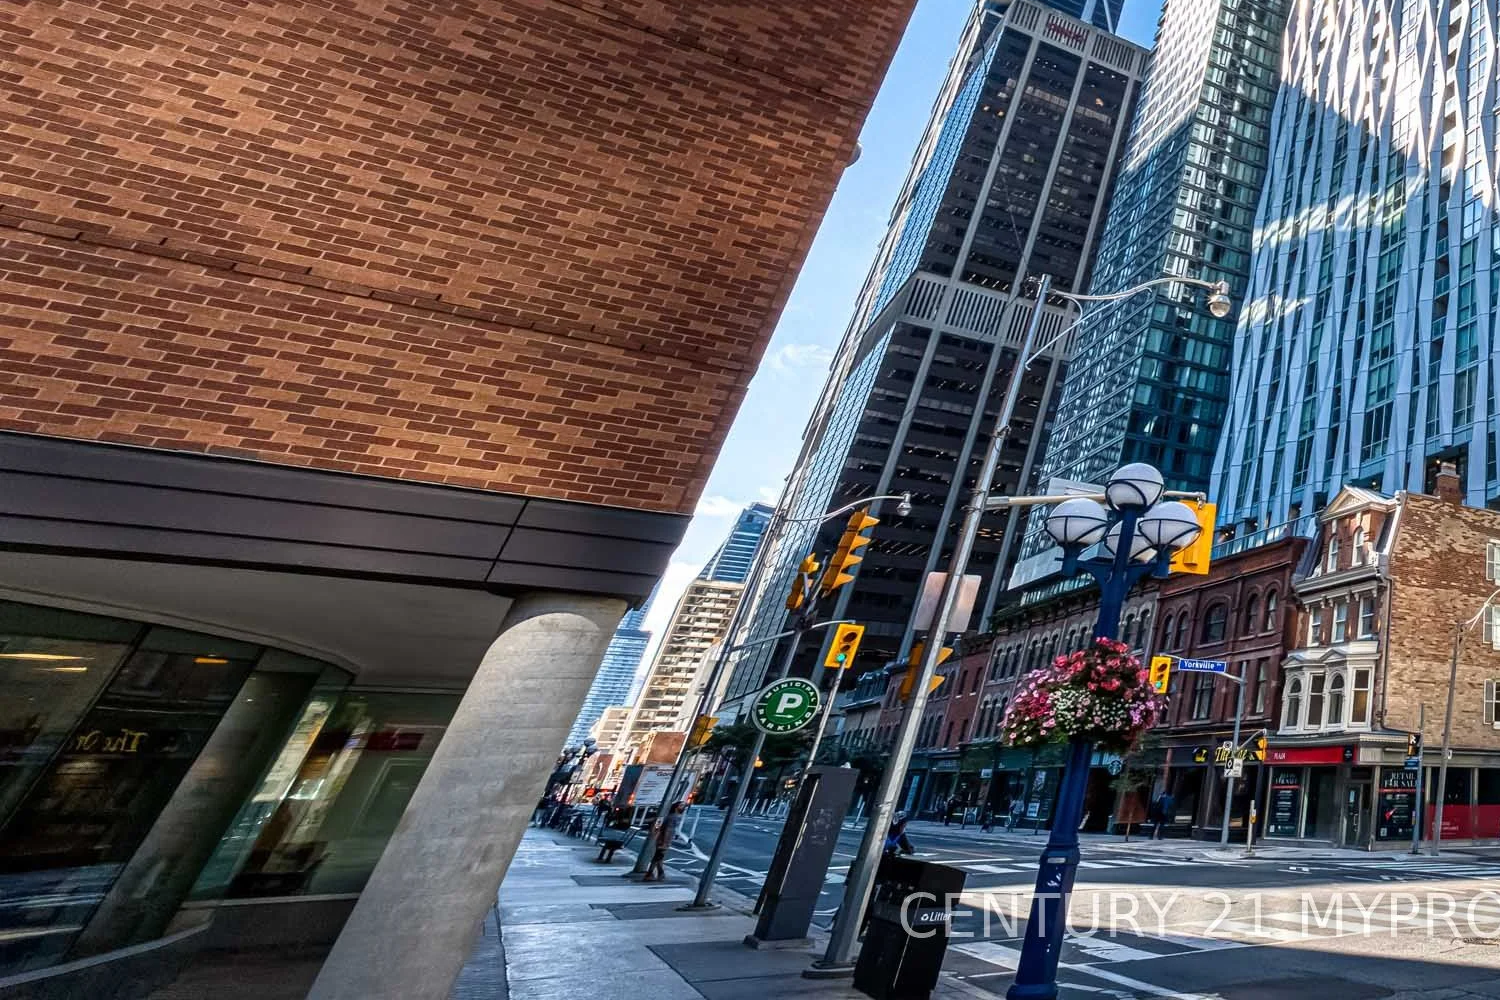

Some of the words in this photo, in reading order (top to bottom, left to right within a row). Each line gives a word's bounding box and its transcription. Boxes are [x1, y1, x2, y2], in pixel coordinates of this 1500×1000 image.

[1184, 660, 1215, 670] Yorkville
[765, 681, 817, 703] MUNICIPAL
[775, 692, 803, 714] P
[758, 709, 811, 731] PARKING
[929, 911, 952, 922] Litter
